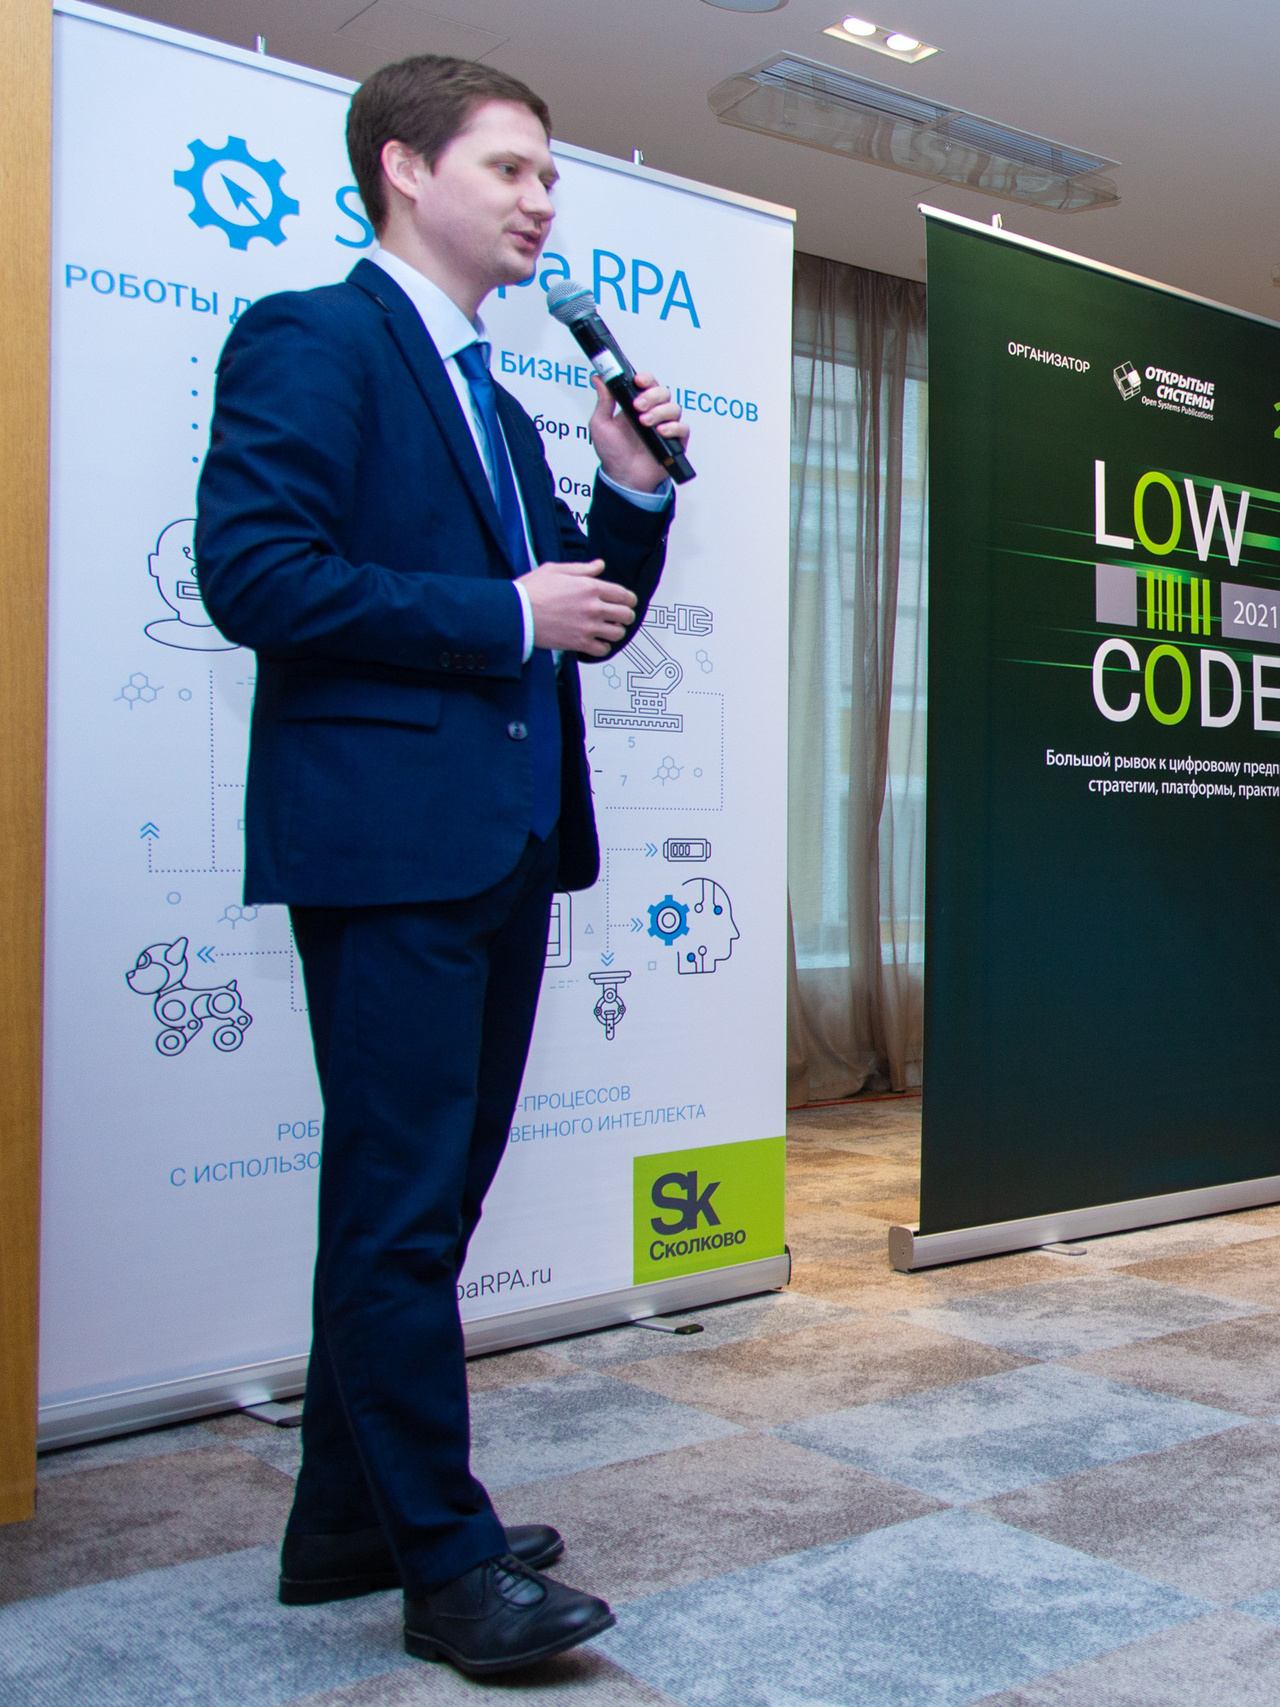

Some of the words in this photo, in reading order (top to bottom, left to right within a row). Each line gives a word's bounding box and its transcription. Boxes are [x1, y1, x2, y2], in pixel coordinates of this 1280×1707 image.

[65, 264, 219, 316] РОБОТЫ
[593, 248, 701, 329] RPA
[1007, 341, 1091, 374] ОРГАНИЗАТОР
[1145, 366, 1215, 396] ОТКРЫТЫЕ
[1141, 395, 1157, 408] Open
[1157, 399, 1180, 413] Systems
[1181, 405, 1214, 421] Publications
[1156, 384, 1215, 411] СИСТЕМЫ
[533, 414, 570, 440] бор
[1095, 459, 1250, 567] LOW
[1232, 600, 1279, 629] 2021
[1046, 749, 1111, 768] Большой
[1114, 754, 1156, 771] рывок
[1159, 759, 1166, 770] к
[1169, 756, 1241, 776] цифровому
[1088, 778, 1159, 796] стратегии,
[1161, 779, 1236, 798] платформы,
[170, 1168, 186, 1187] С
[194, 1151, 321, 1184] ИСПОЛЬЗО
[510, 1117, 593, 1144] ВЕННОГО
[598, 1104, 706, 1132] ИНТЕЛЛЕКТА
[651, 1170, 721, 1235] Sk
